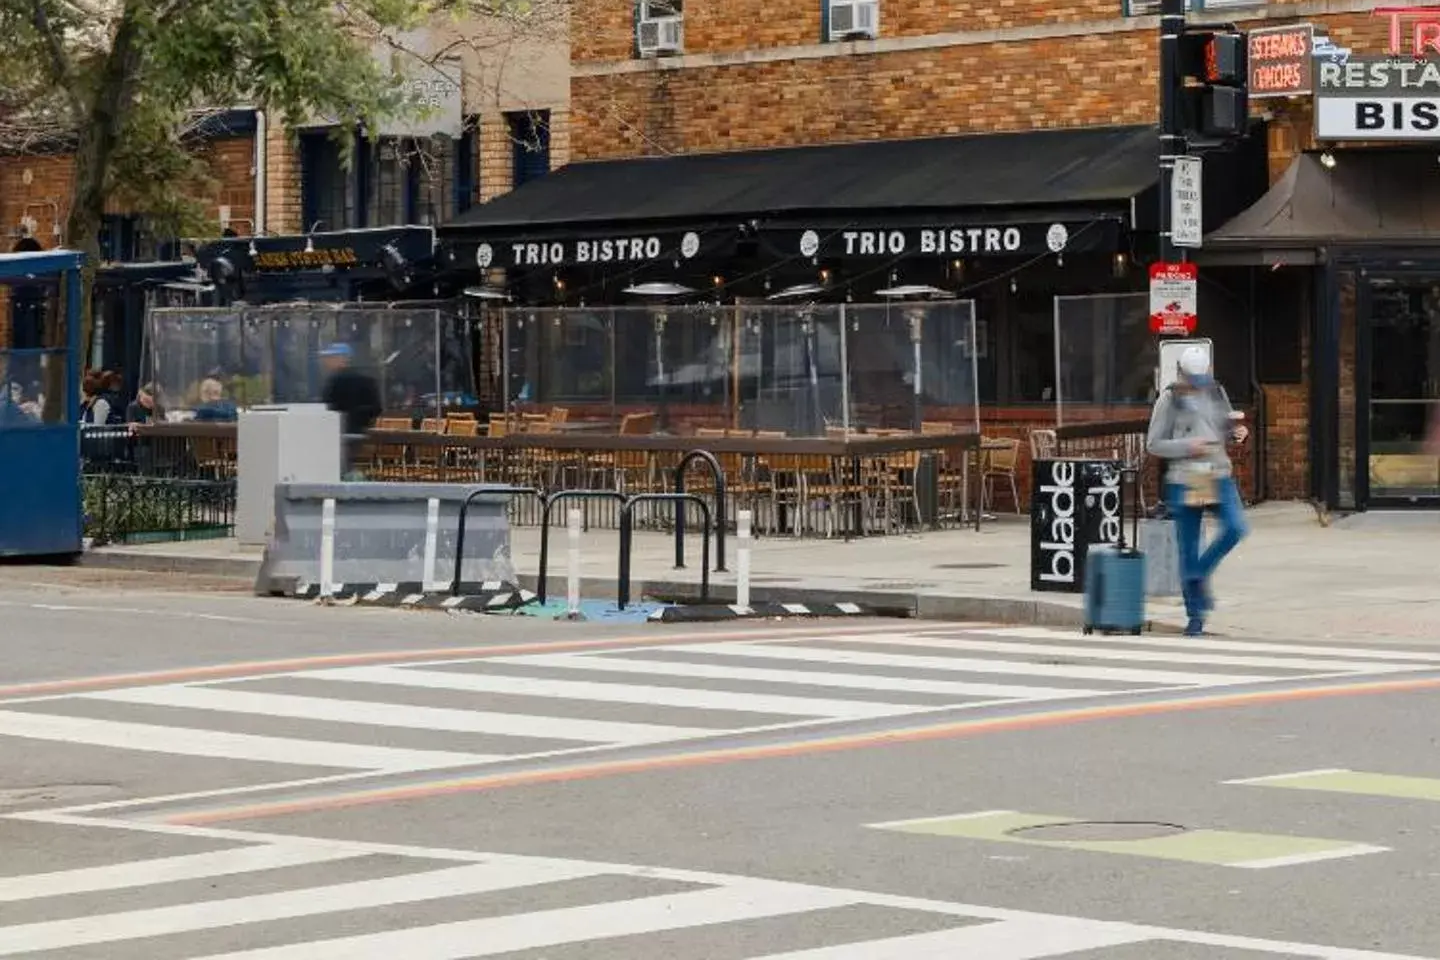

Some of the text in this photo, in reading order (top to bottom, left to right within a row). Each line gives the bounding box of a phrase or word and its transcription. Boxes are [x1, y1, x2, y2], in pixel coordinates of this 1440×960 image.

[512, 243, 564, 265] TRIO
[576, 237, 661, 262] BISTRO
[844, 231, 905, 254] TRIO
[920, 228, 1021, 254] BISTRO
[1040, 462, 1074, 582] blade
